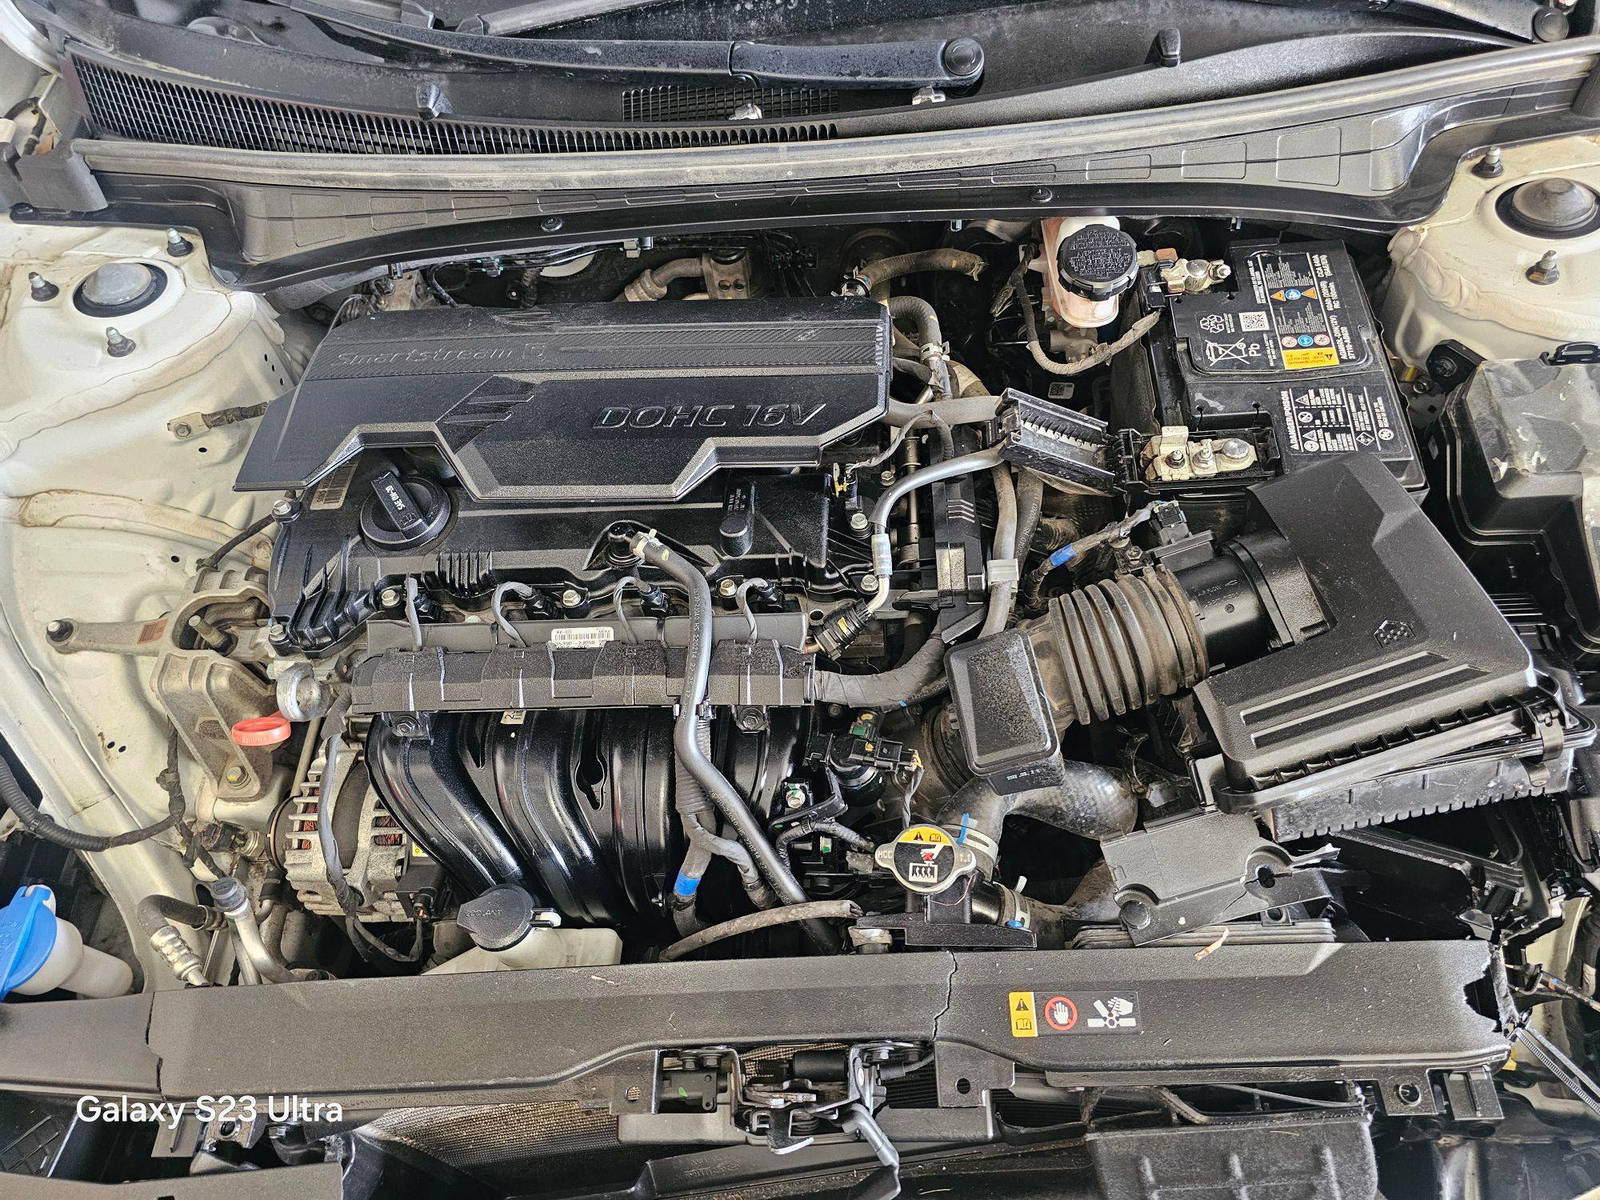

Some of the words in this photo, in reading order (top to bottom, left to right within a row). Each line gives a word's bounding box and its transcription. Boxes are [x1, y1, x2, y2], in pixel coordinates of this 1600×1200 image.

[337, 347, 513, 366] Smartstream
[1249, 343, 1261, 357] Pb
[592, 404, 735, 429] DOHC
[742, 403, 827, 427] 16V
[1281, 390, 1299, 444] DANGER/POISON
[393, 498, 406, 510] SAE
